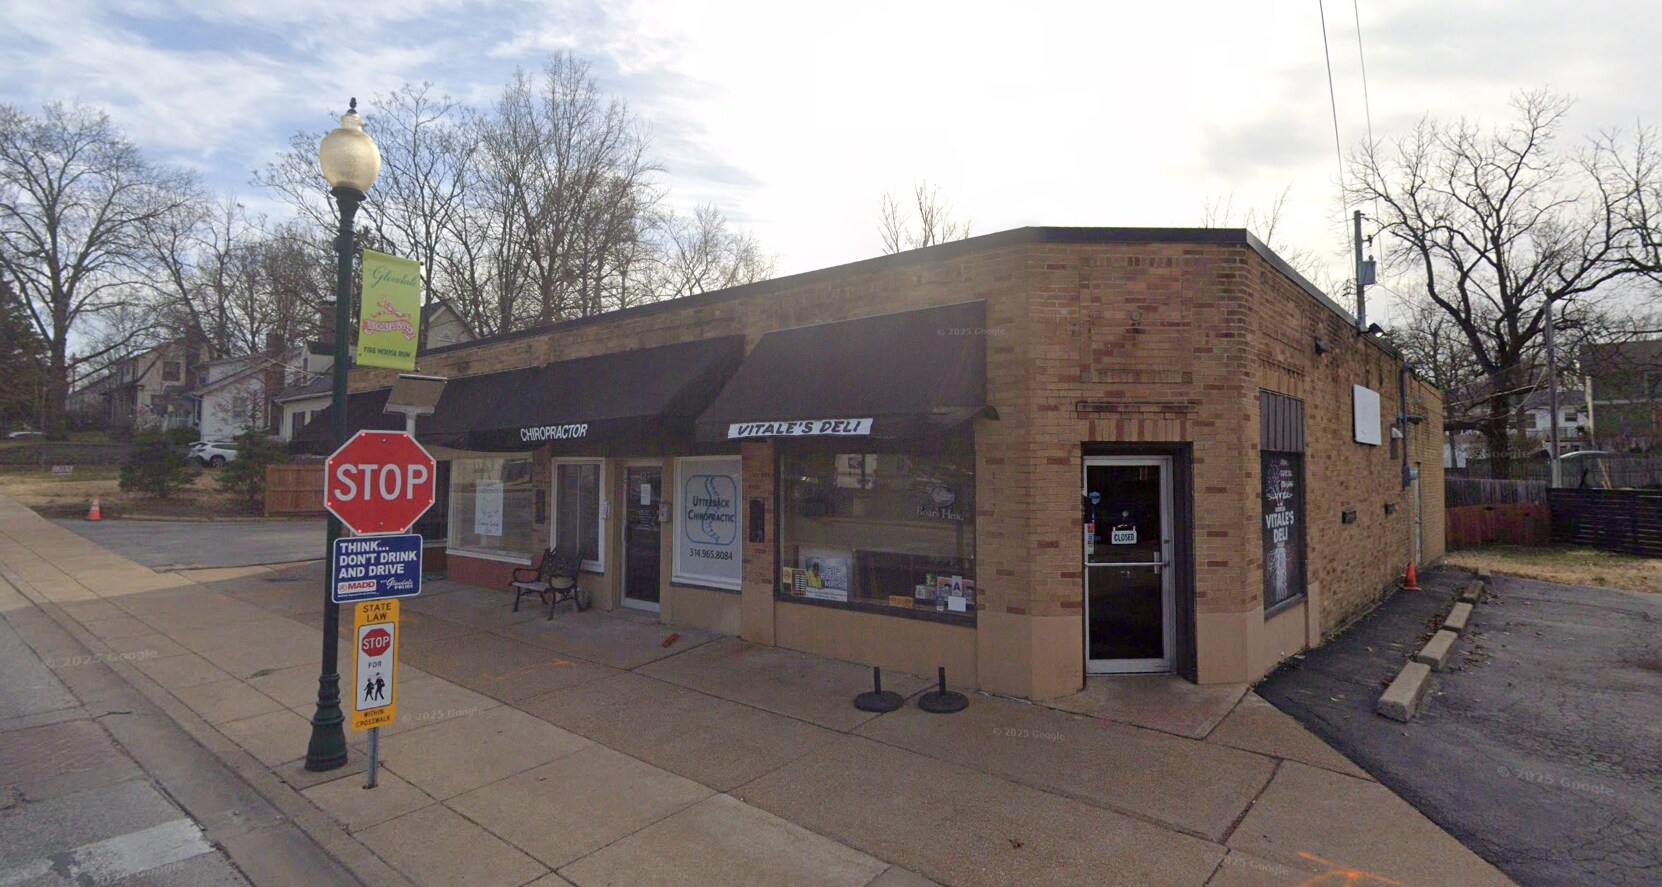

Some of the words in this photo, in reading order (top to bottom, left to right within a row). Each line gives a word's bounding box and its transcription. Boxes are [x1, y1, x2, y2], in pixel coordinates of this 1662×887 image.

[364, 346, 376, 354] FIRE
[378, 348, 397, 357] HOUSE
[398, 350, 411, 358] RUN
[520, 424, 588, 442] CHIROPRACTOR
[737, 420, 814, 436] VITALE'S
[819, 420, 862, 433] DELI
[334, 463, 428, 501] STOP
[1265, 510, 1295, 530] VITALE'S
[1113, 533, 1135, 542] CLOSED
[1273, 526, 1288, 544] DELI
[340, 540, 389, 553] THINK...
[339, 554, 377, 566] DON'T
[380, 551, 417, 563] DRINK
[689, 548, 733, 560] 314.965.8084
[339, 566, 366, 579] AND
[368, 564, 405, 576] DRIVE
[347, 580, 376, 590] MADD
[953, 582, 961, 591] A
[363, 602, 392, 613] STATE
[367, 612, 387, 622] LAW
[362, 636, 390, 650] STOP
[363, 709, 384, 718] WITHIN
[355, 716, 391, 728] CROSSWALK
